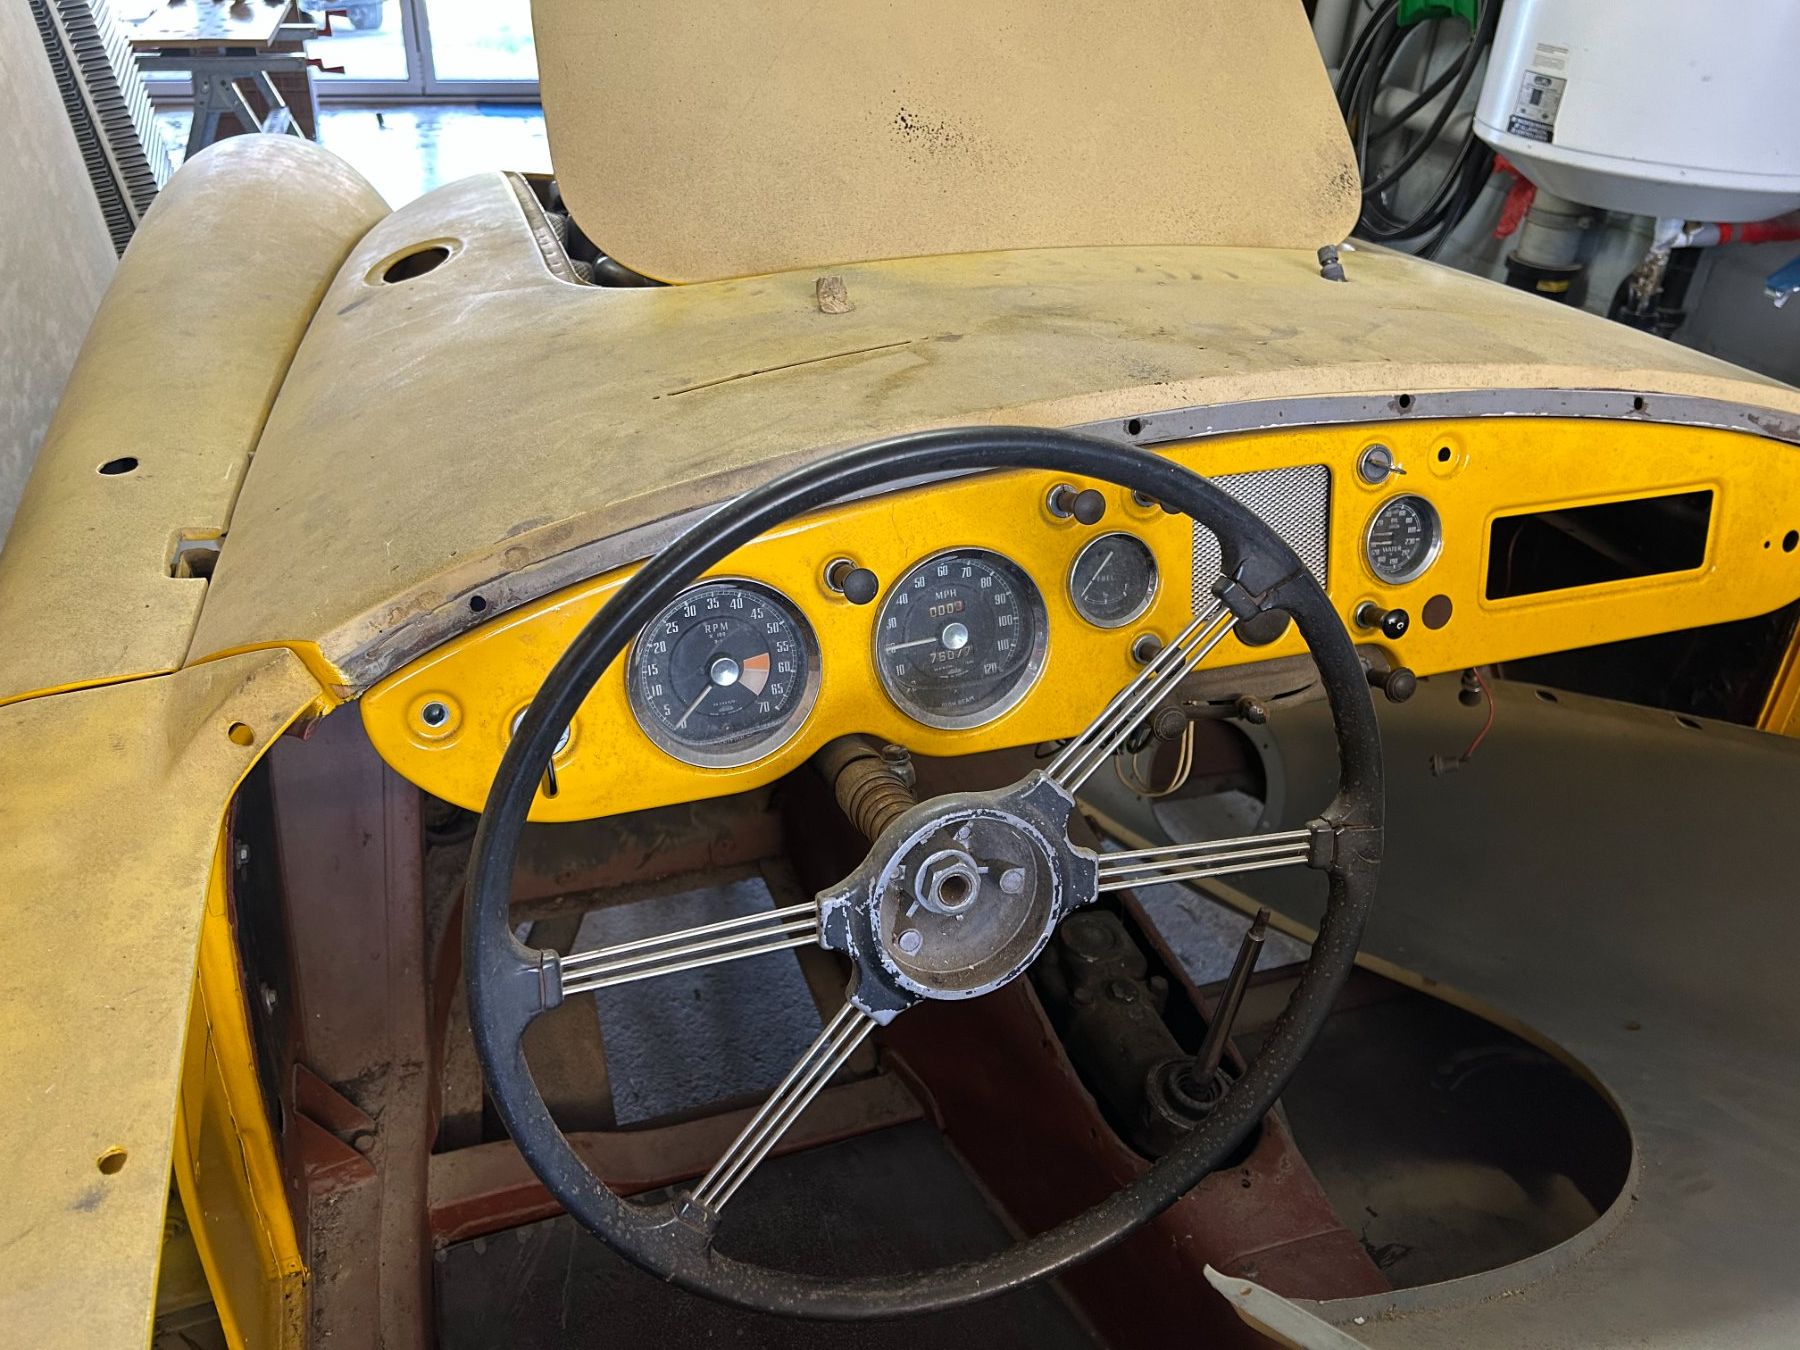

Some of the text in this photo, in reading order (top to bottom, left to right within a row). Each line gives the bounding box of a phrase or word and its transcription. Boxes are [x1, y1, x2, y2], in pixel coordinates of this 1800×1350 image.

[937, 565, 948, 577] 60
[961, 566, 972, 578] 70
[914, 576, 925, 588] 50
[980, 576, 992, 588] 80
[896, 593, 908, 606] 40
[935, 589, 957, 600] MPH
[994, 593, 1006, 605] 90
[706, 597, 720, 610] 35
[729, 597, 743, 610] 40
[683, 605, 697, 618] 30
[750, 607, 764, 620] 45
[886, 617, 897, 630] 30
[999, 614, 1013, 627] 100
[665, 621, 679, 635] 25
[767, 622, 779, 634] 50
[653, 640, 667, 654] 20
[776, 641, 789, 653] 55
[997, 639, 1009, 651] 110
[648, 663, 659, 676] 15
[778, 661, 790, 673] 60
[896, 664, 905, 677] 10
[983, 662, 997, 675] 120
[651, 684, 663, 696] 10
[771, 683, 784, 695] 65
[664, 703, 671, 716] 5
[758, 702, 770, 714] 70
